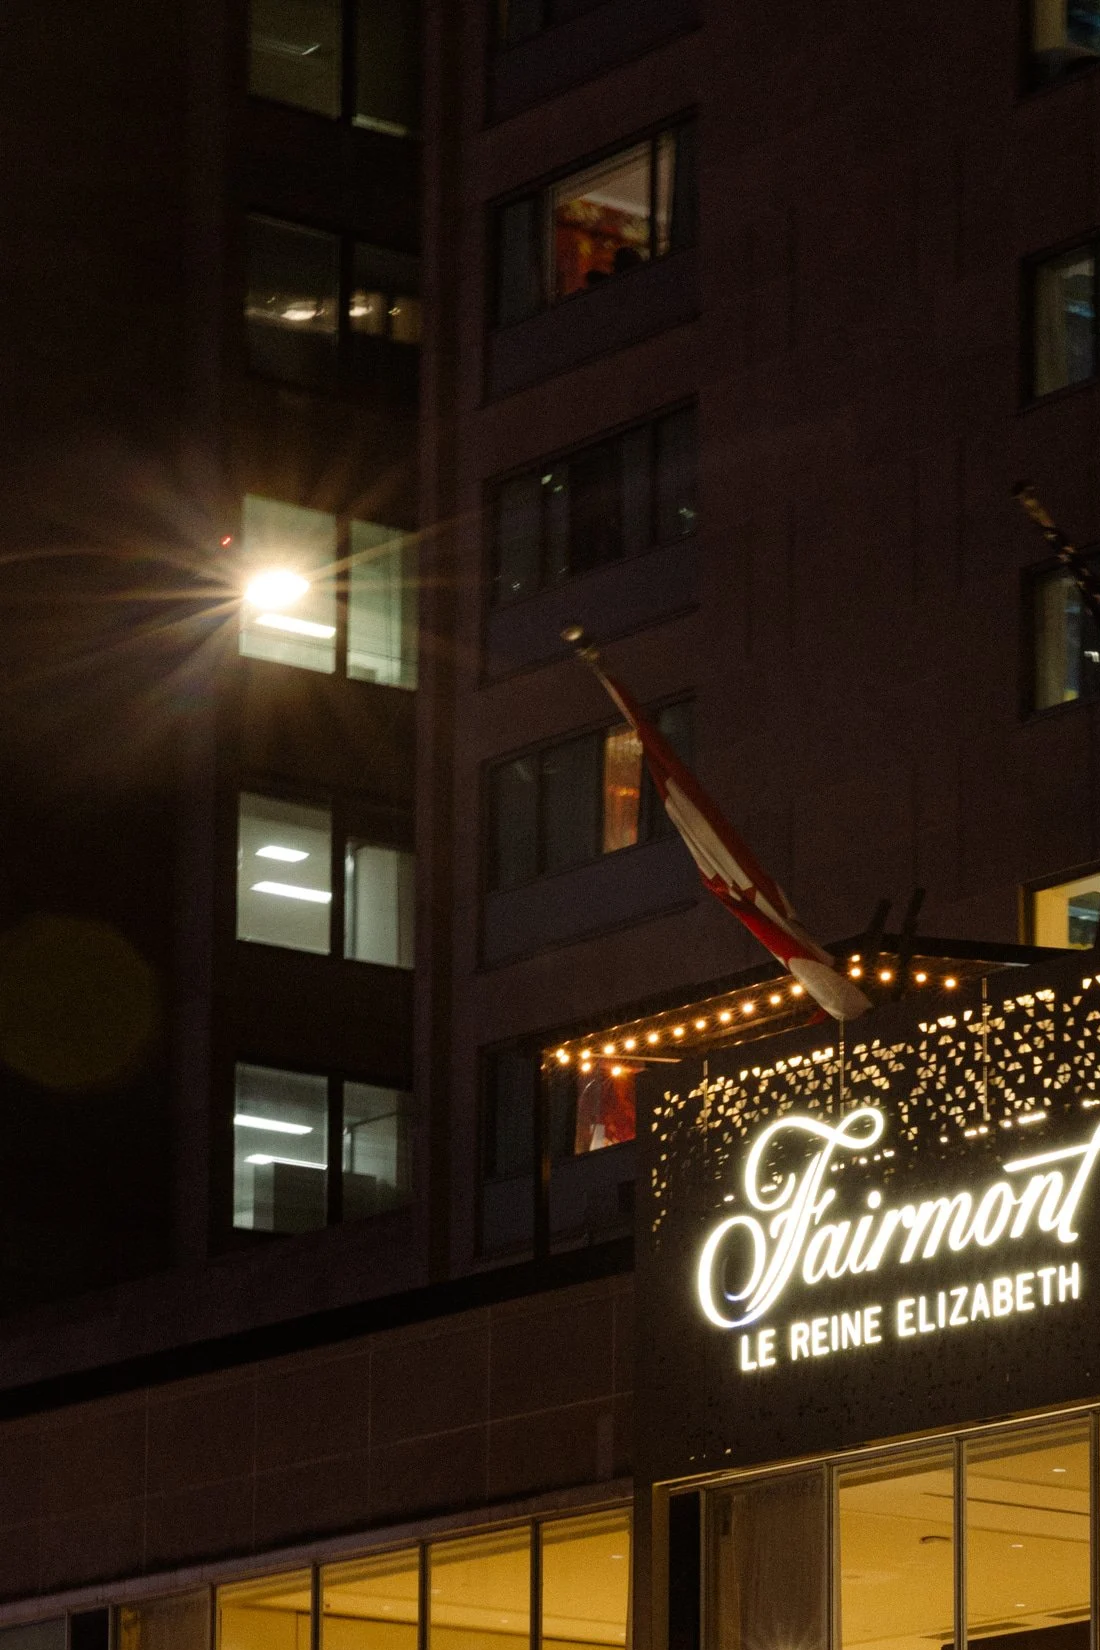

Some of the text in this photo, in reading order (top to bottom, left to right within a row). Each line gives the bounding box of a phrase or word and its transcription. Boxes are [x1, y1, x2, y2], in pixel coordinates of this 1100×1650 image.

[740, 1262, 1081, 1372] LE REINE ELIZABETH
